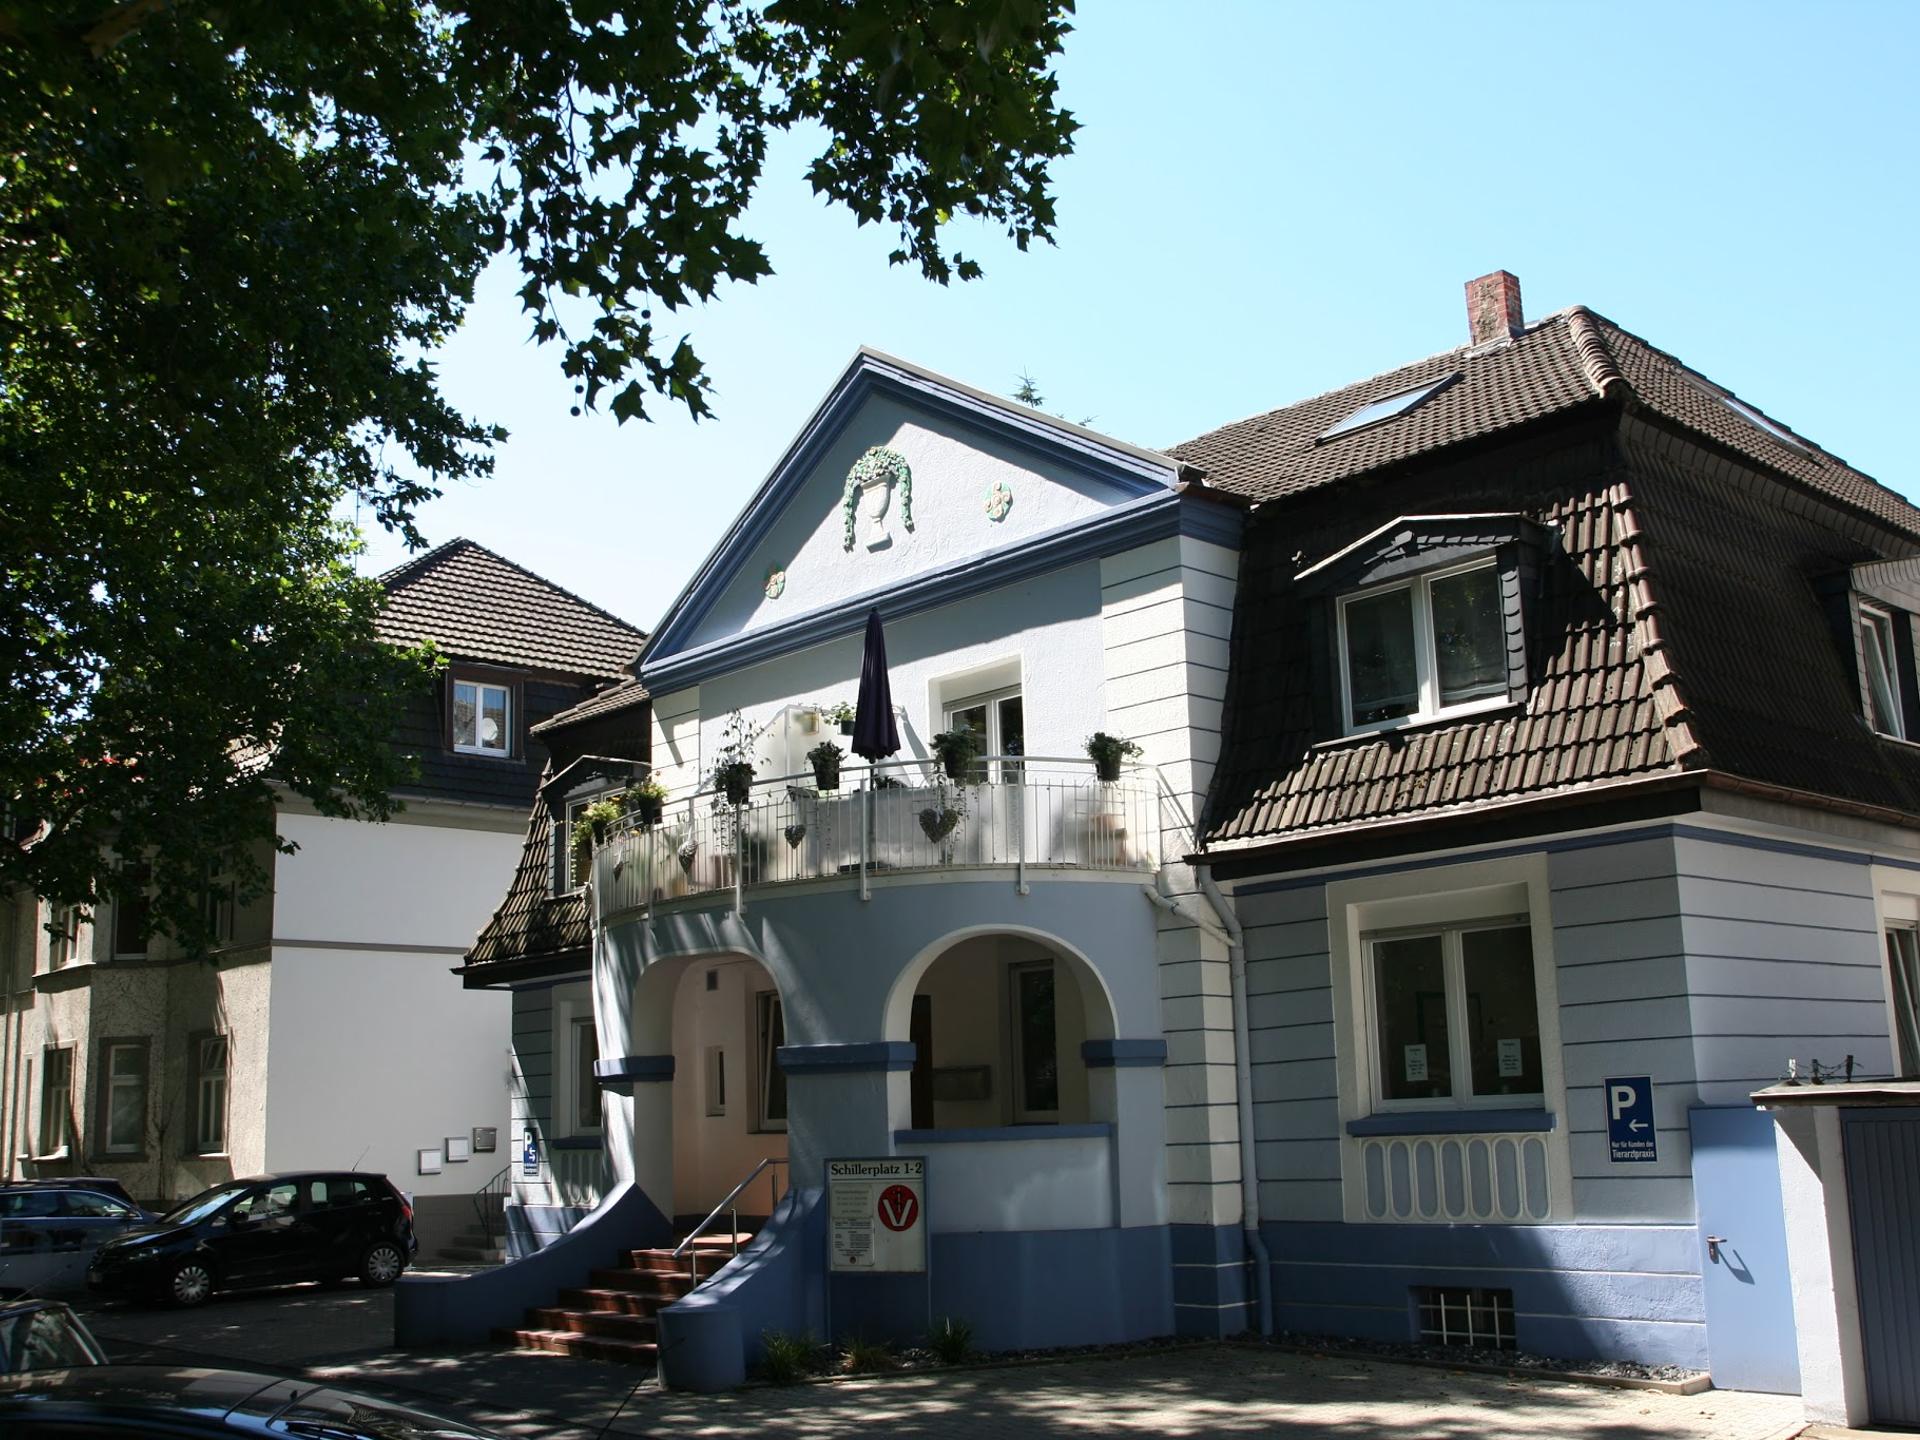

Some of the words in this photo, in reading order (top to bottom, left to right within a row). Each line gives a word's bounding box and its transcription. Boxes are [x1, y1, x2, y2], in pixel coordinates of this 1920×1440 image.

[1610, 1085, 1636, 1120] P
[524, 1131, 533, 1152] P
[1612, 1148, 1655, 1160] Tierarztpraxis
[831, 1163, 900, 1177] Schillerplatz
[904, 1162, 922, 1174] 1-2
[882, 1199, 913, 1227] V
